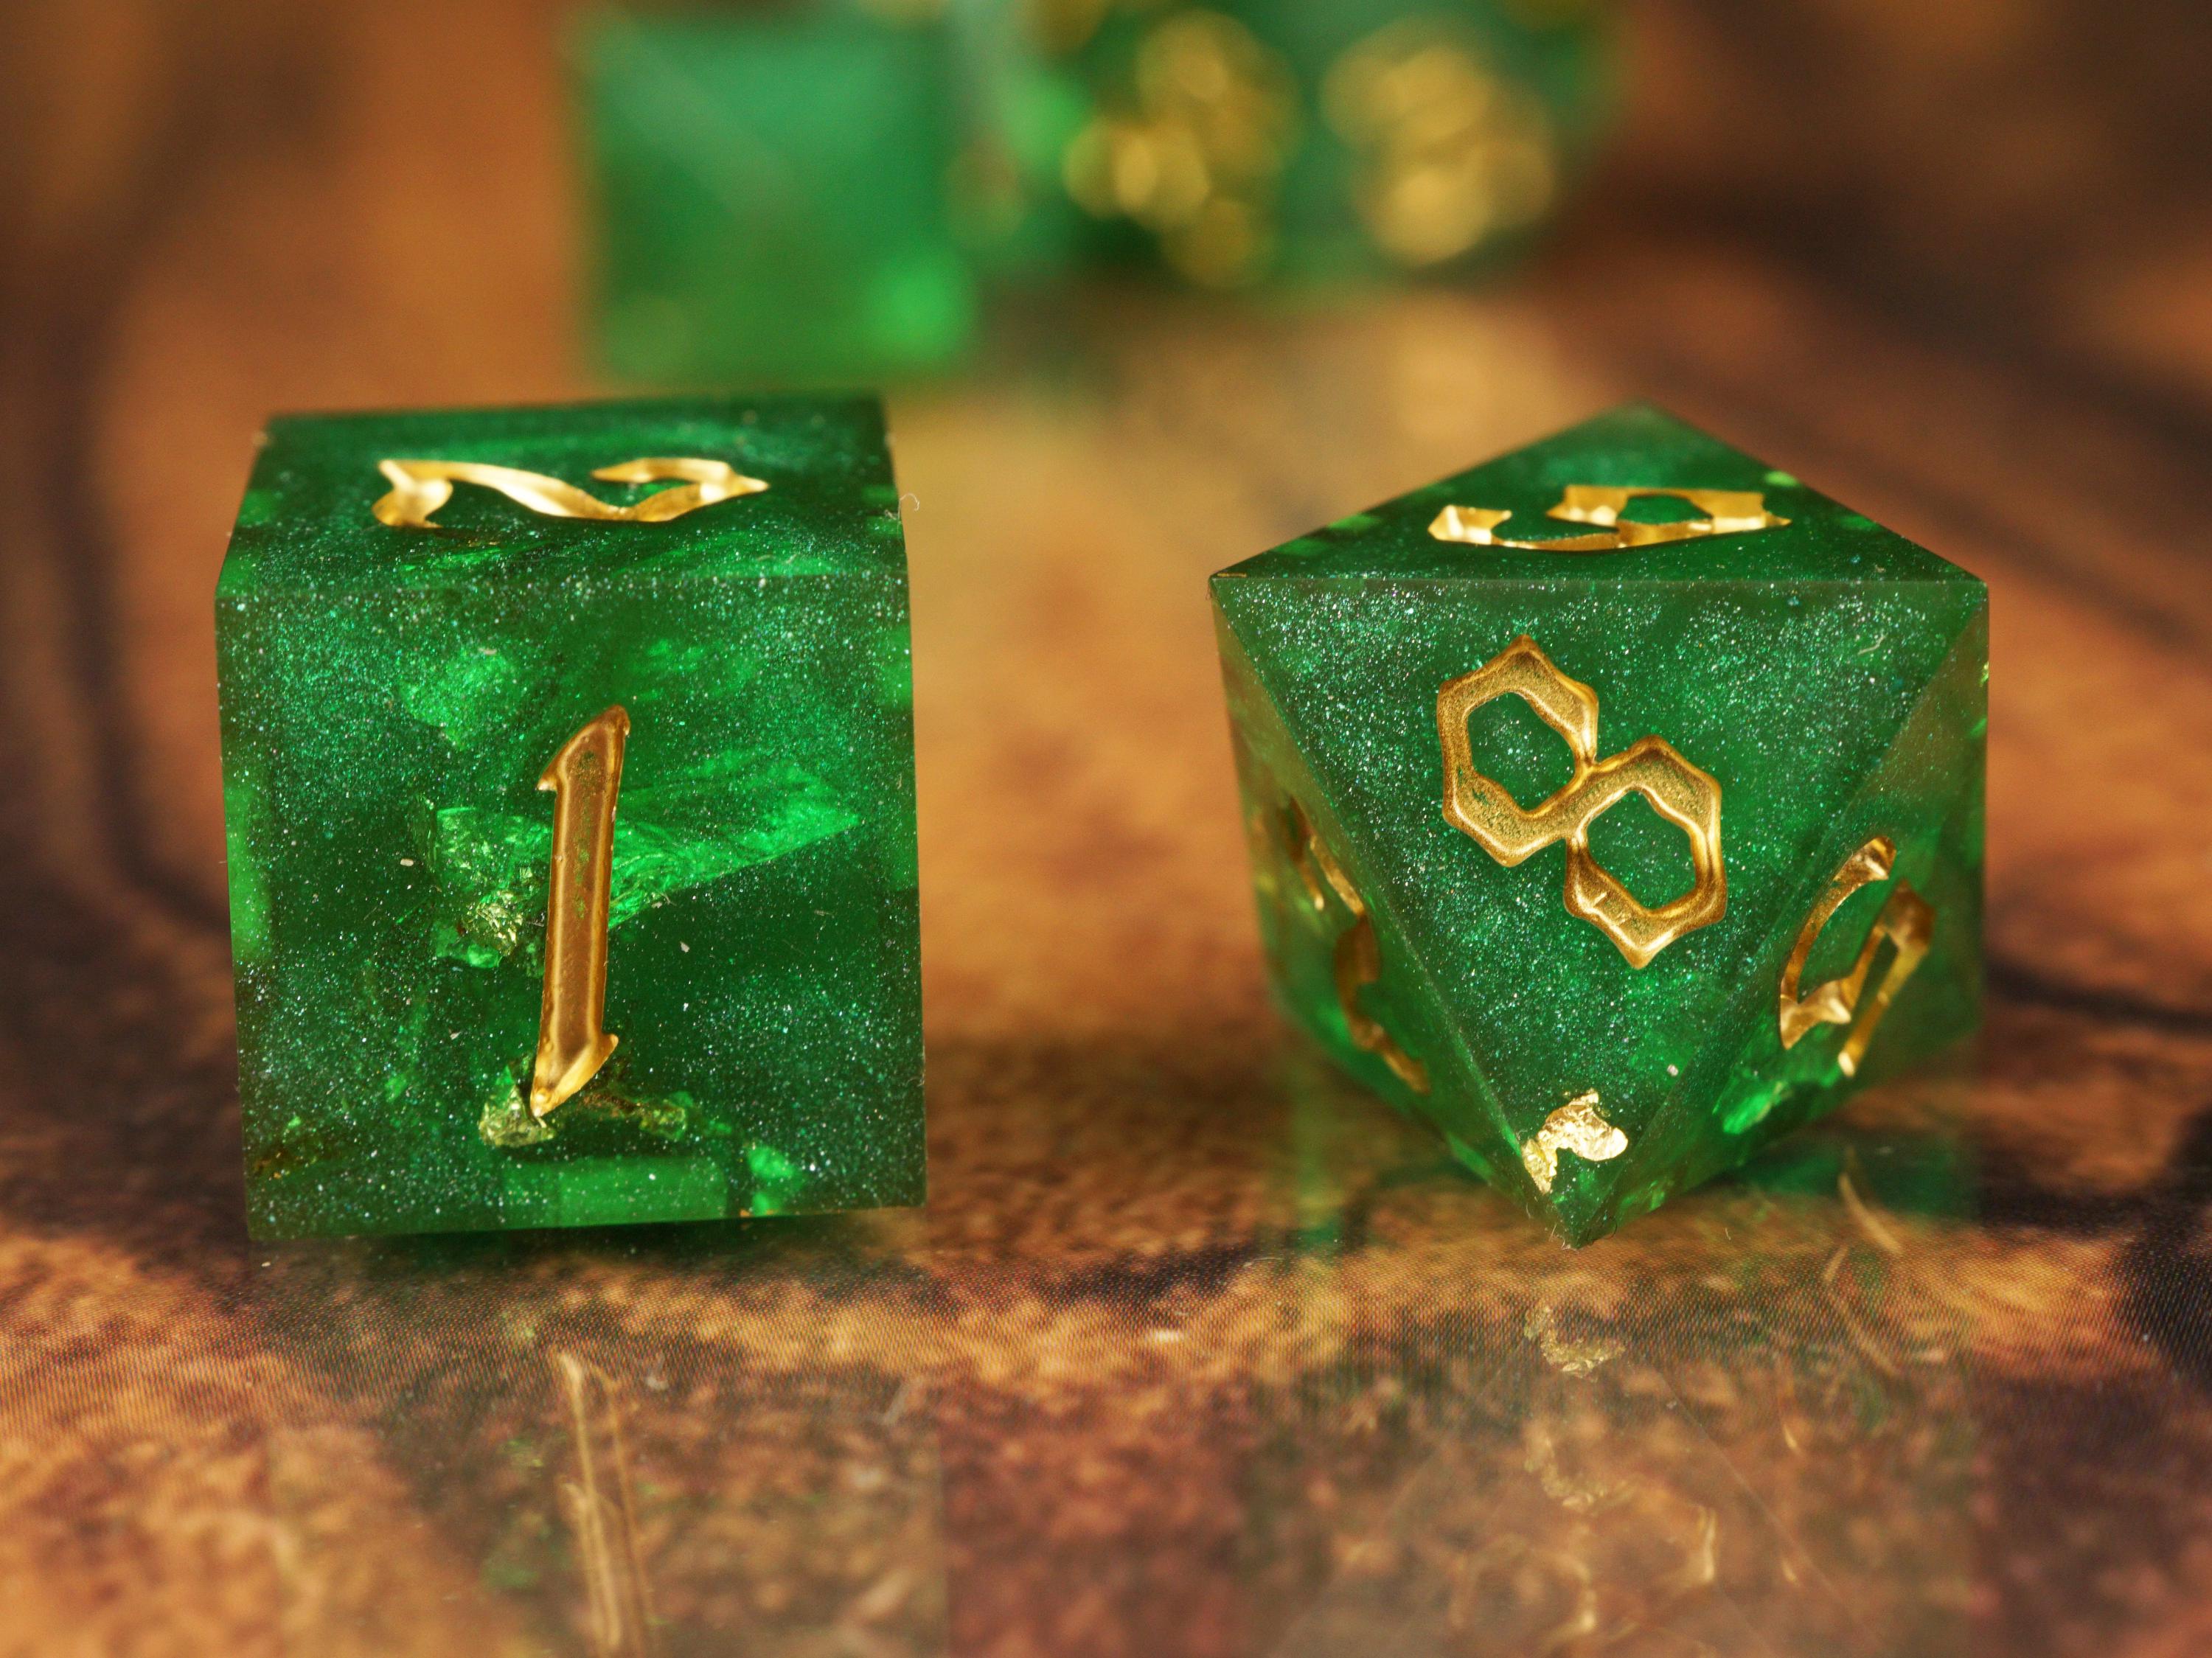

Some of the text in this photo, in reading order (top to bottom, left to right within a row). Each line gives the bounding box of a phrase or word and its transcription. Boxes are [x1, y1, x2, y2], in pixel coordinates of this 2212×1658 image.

[372, 457, 769, 528] 2
[529, 703, 631, 1118] 1
[1436, 633, 1728, 969] 8
